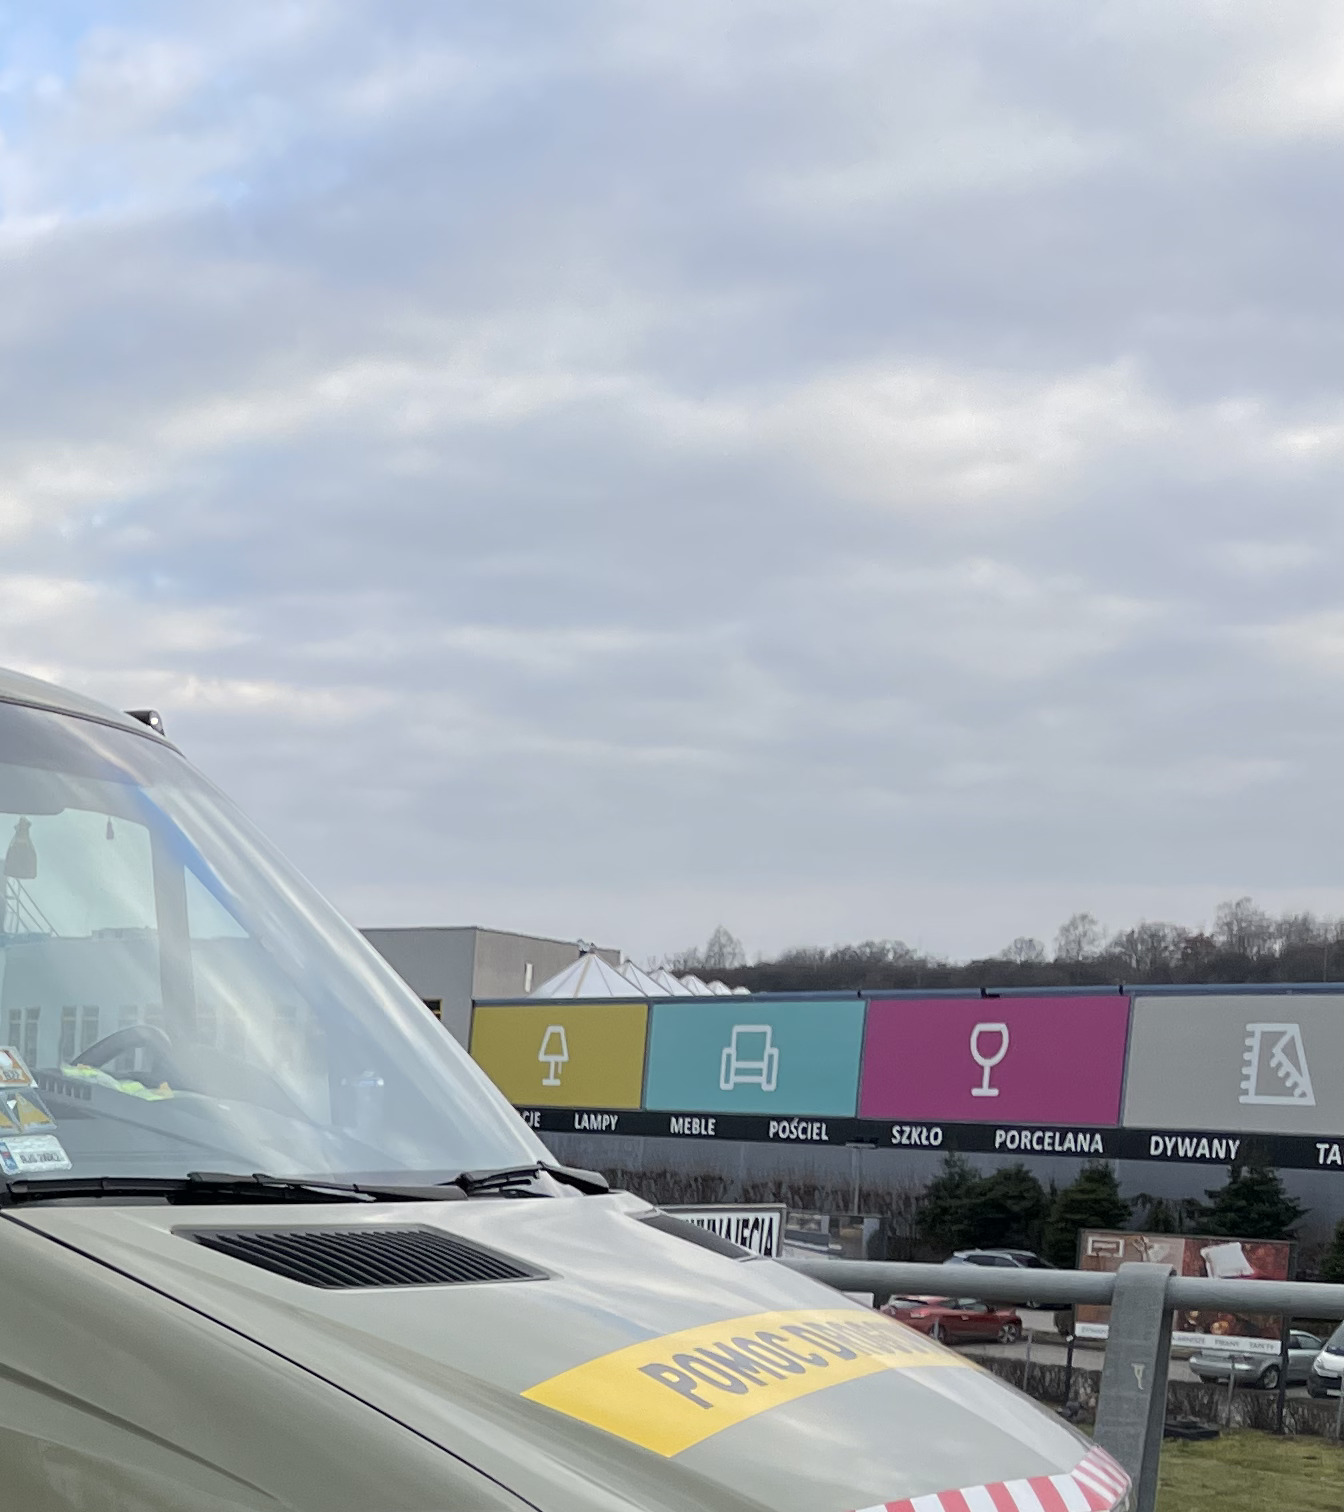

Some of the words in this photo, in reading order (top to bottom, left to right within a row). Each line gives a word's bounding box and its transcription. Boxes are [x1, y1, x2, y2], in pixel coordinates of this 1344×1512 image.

[574, 1113, 619, 1131] LAMPY
[670, 1116, 716, 1136] MEBLE
[769, 1117, 829, 1141] POŚCIEL
[891, 1125, 943, 1147] SZKŁO
[994, 1129, 1104, 1154] PORCELANA
[1150, 1135, 1241, 1160] DYWANY
[637, 1329, 830, 1410] POMOC
